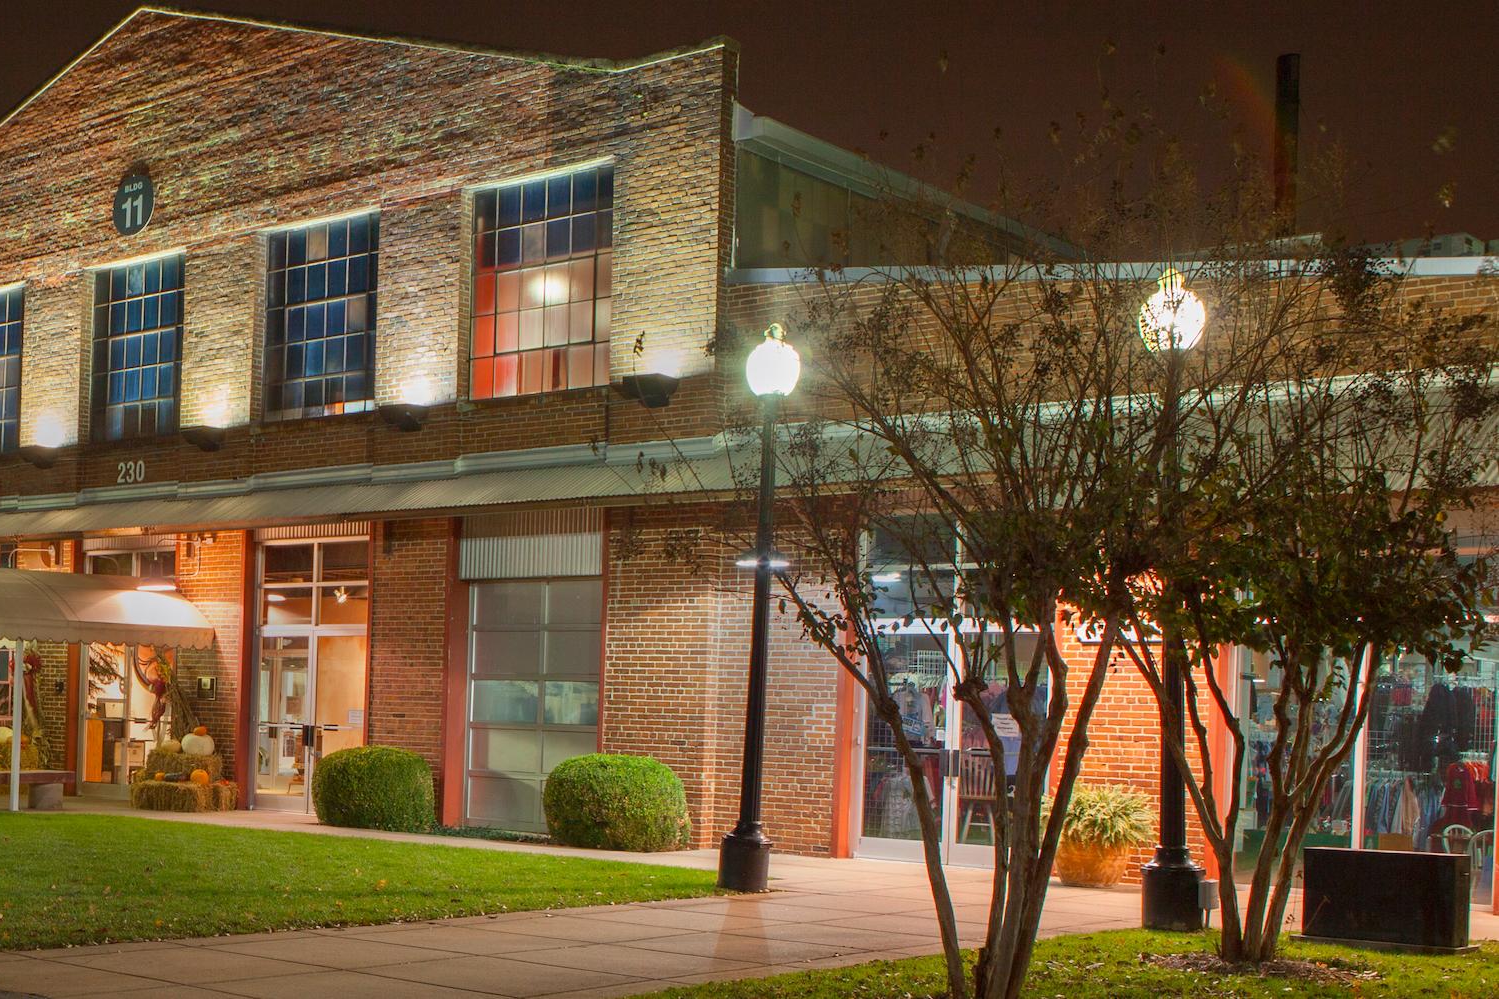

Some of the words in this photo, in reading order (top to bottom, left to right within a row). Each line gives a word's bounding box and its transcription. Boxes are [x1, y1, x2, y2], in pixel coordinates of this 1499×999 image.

[124, 181, 143, 193] BLDG
[121, 194, 143, 229] 11
[117, 460, 145, 484] 230
